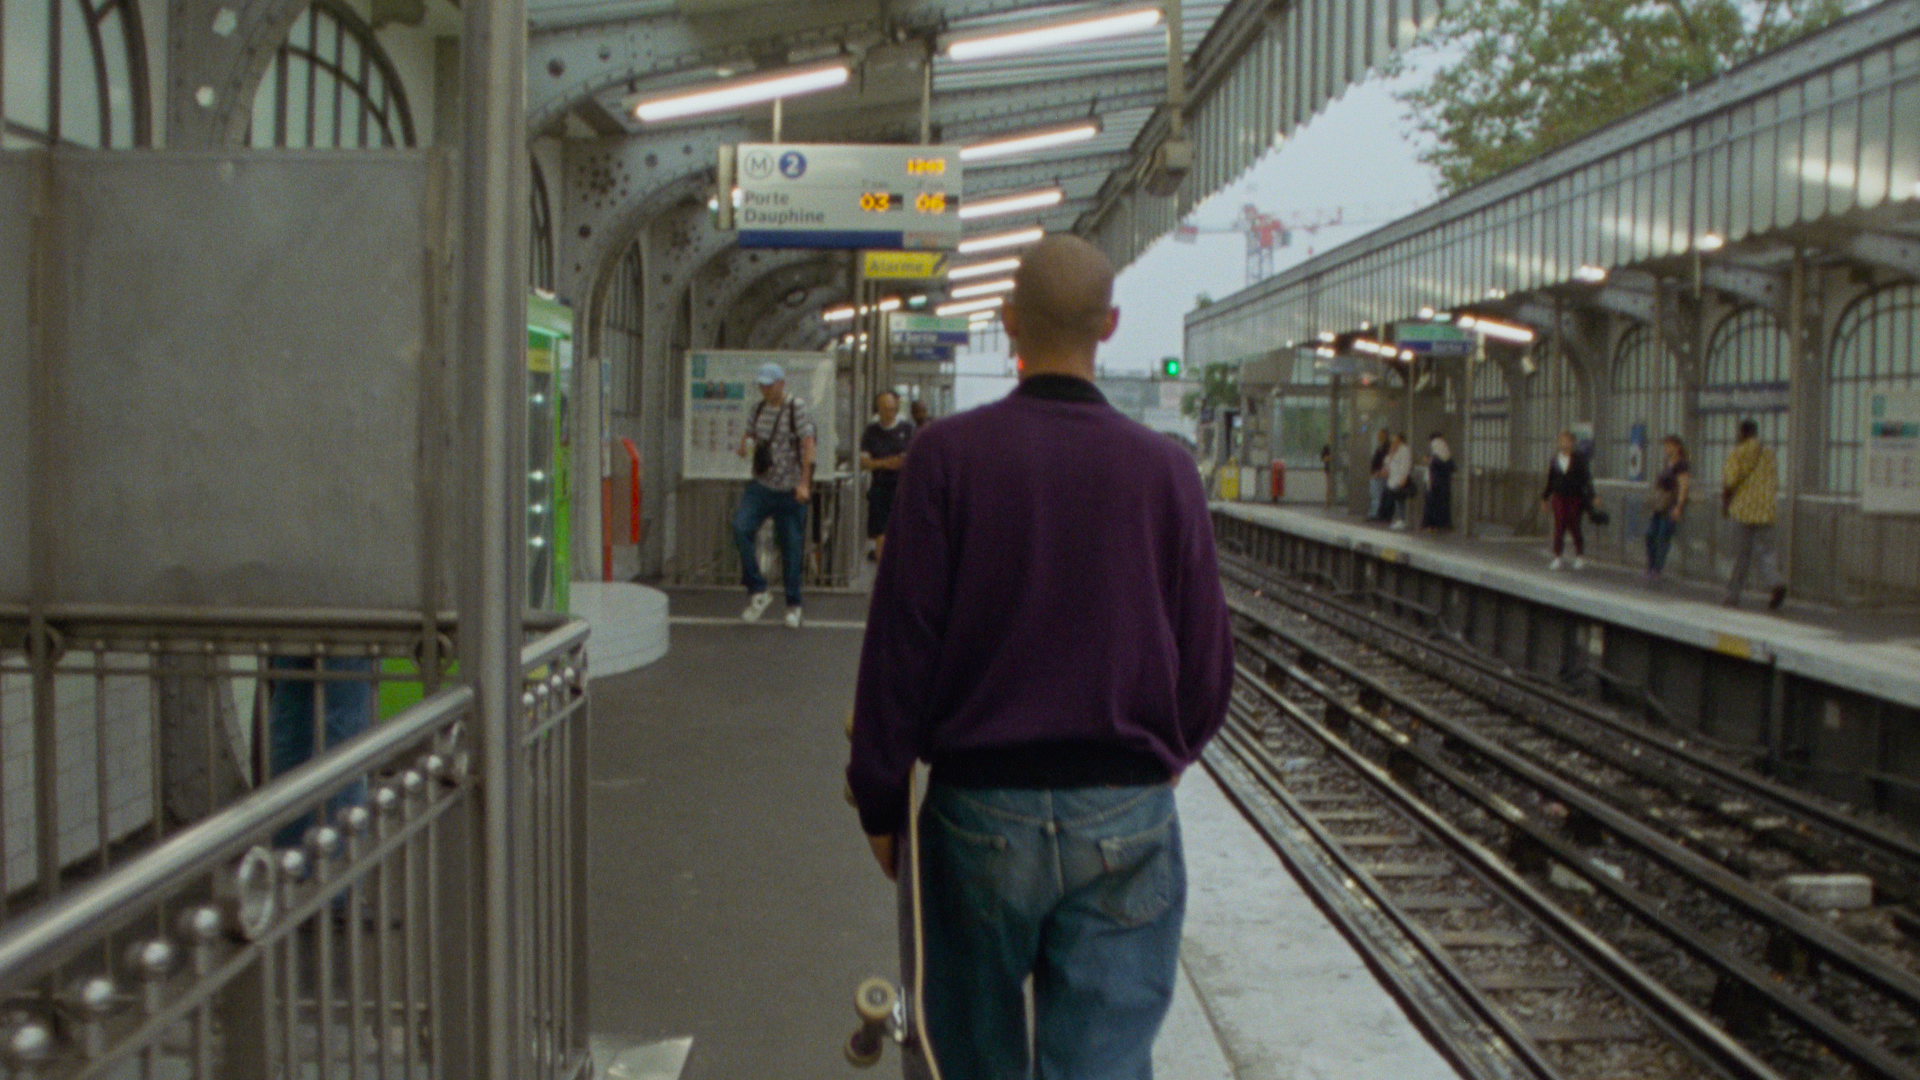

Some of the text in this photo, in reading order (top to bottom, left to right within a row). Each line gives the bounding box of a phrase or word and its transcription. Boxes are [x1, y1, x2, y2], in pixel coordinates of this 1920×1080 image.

[786, 153, 801, 176] 2
[744, 190, 789, 204] Porte
[860, 192, 890, 212] 03
[744, 209, 825, 225] Dauphine
[869, 258, 925, 272] Alarme
